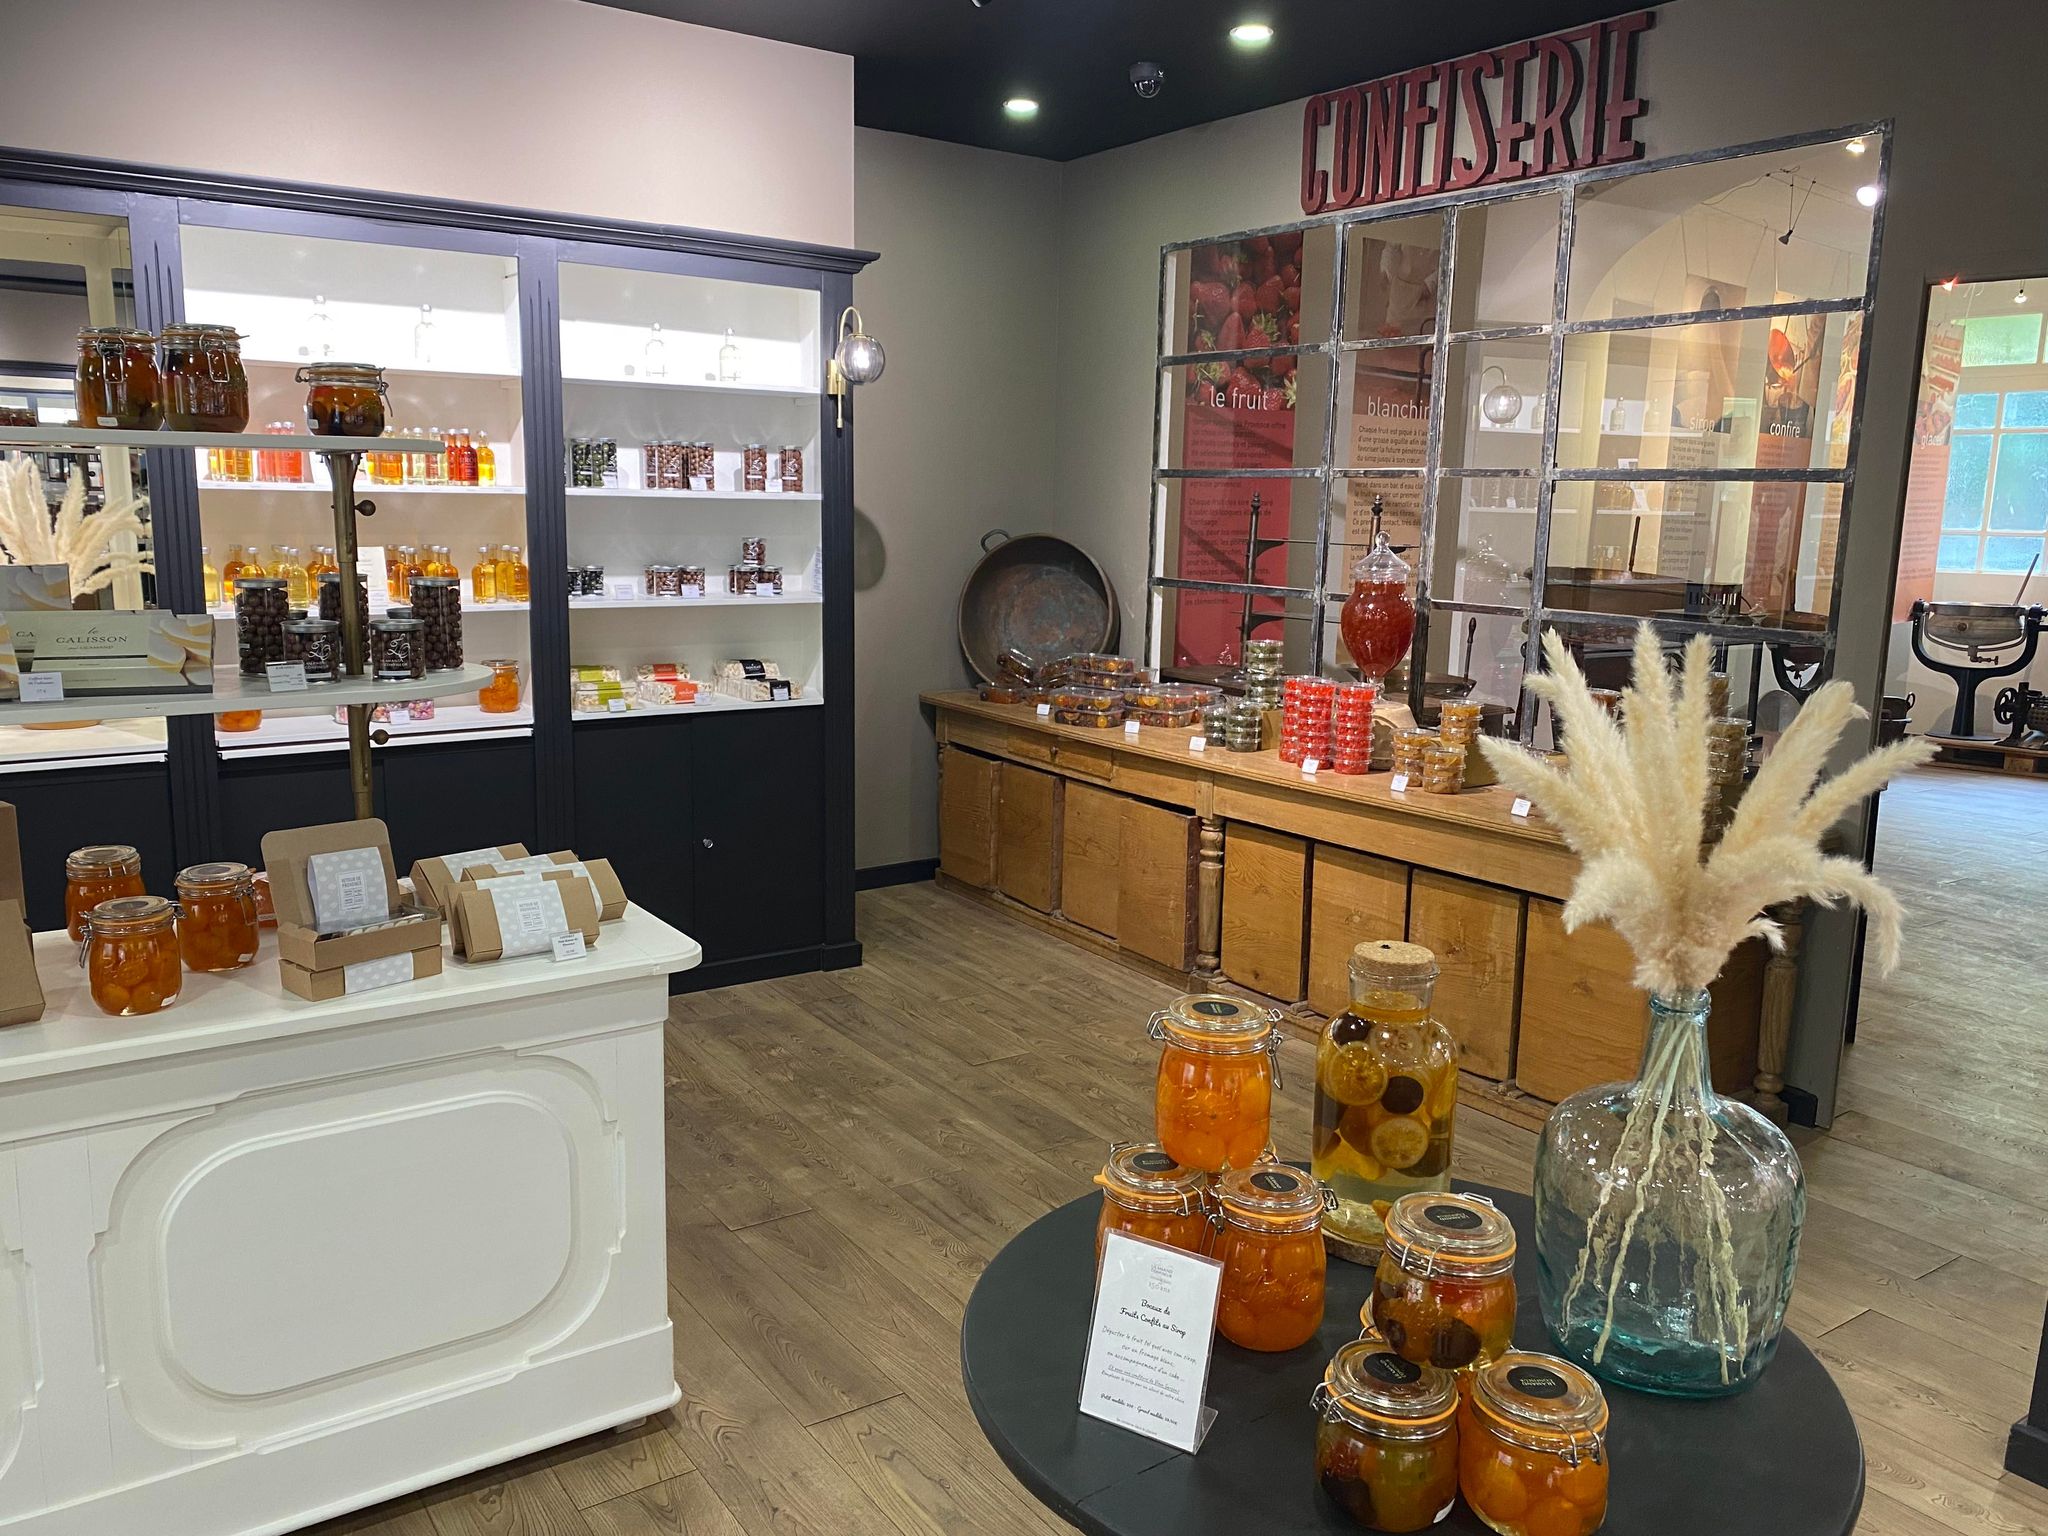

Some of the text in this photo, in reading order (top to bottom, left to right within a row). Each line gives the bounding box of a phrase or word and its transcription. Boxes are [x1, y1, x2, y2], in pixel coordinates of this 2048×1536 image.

[1300, 12, 1653, 215] CONFISERIE
[1210, 386, 1268, 411] le fruit
[1367, 395, 1430, 420] blanchir
[1769, 421, 1801, 438] confire
[55, 635, 128, 644] CALISSON
[1163, 1306, 1171, 1316] de
[1119, 1307, 1139, 1320] Fruits
[1140, 1313, 1161, 1328] Confits
[1170, 1324, 1187, 1339] Sirop
[1101, 1325, 1125, 1339] Déguster
[1131, 1334, 1144, 1344] fruit
[1115, 1352, 1158, 1372] accompagnement
[1139, 1347, 1160, 1362] fromage
